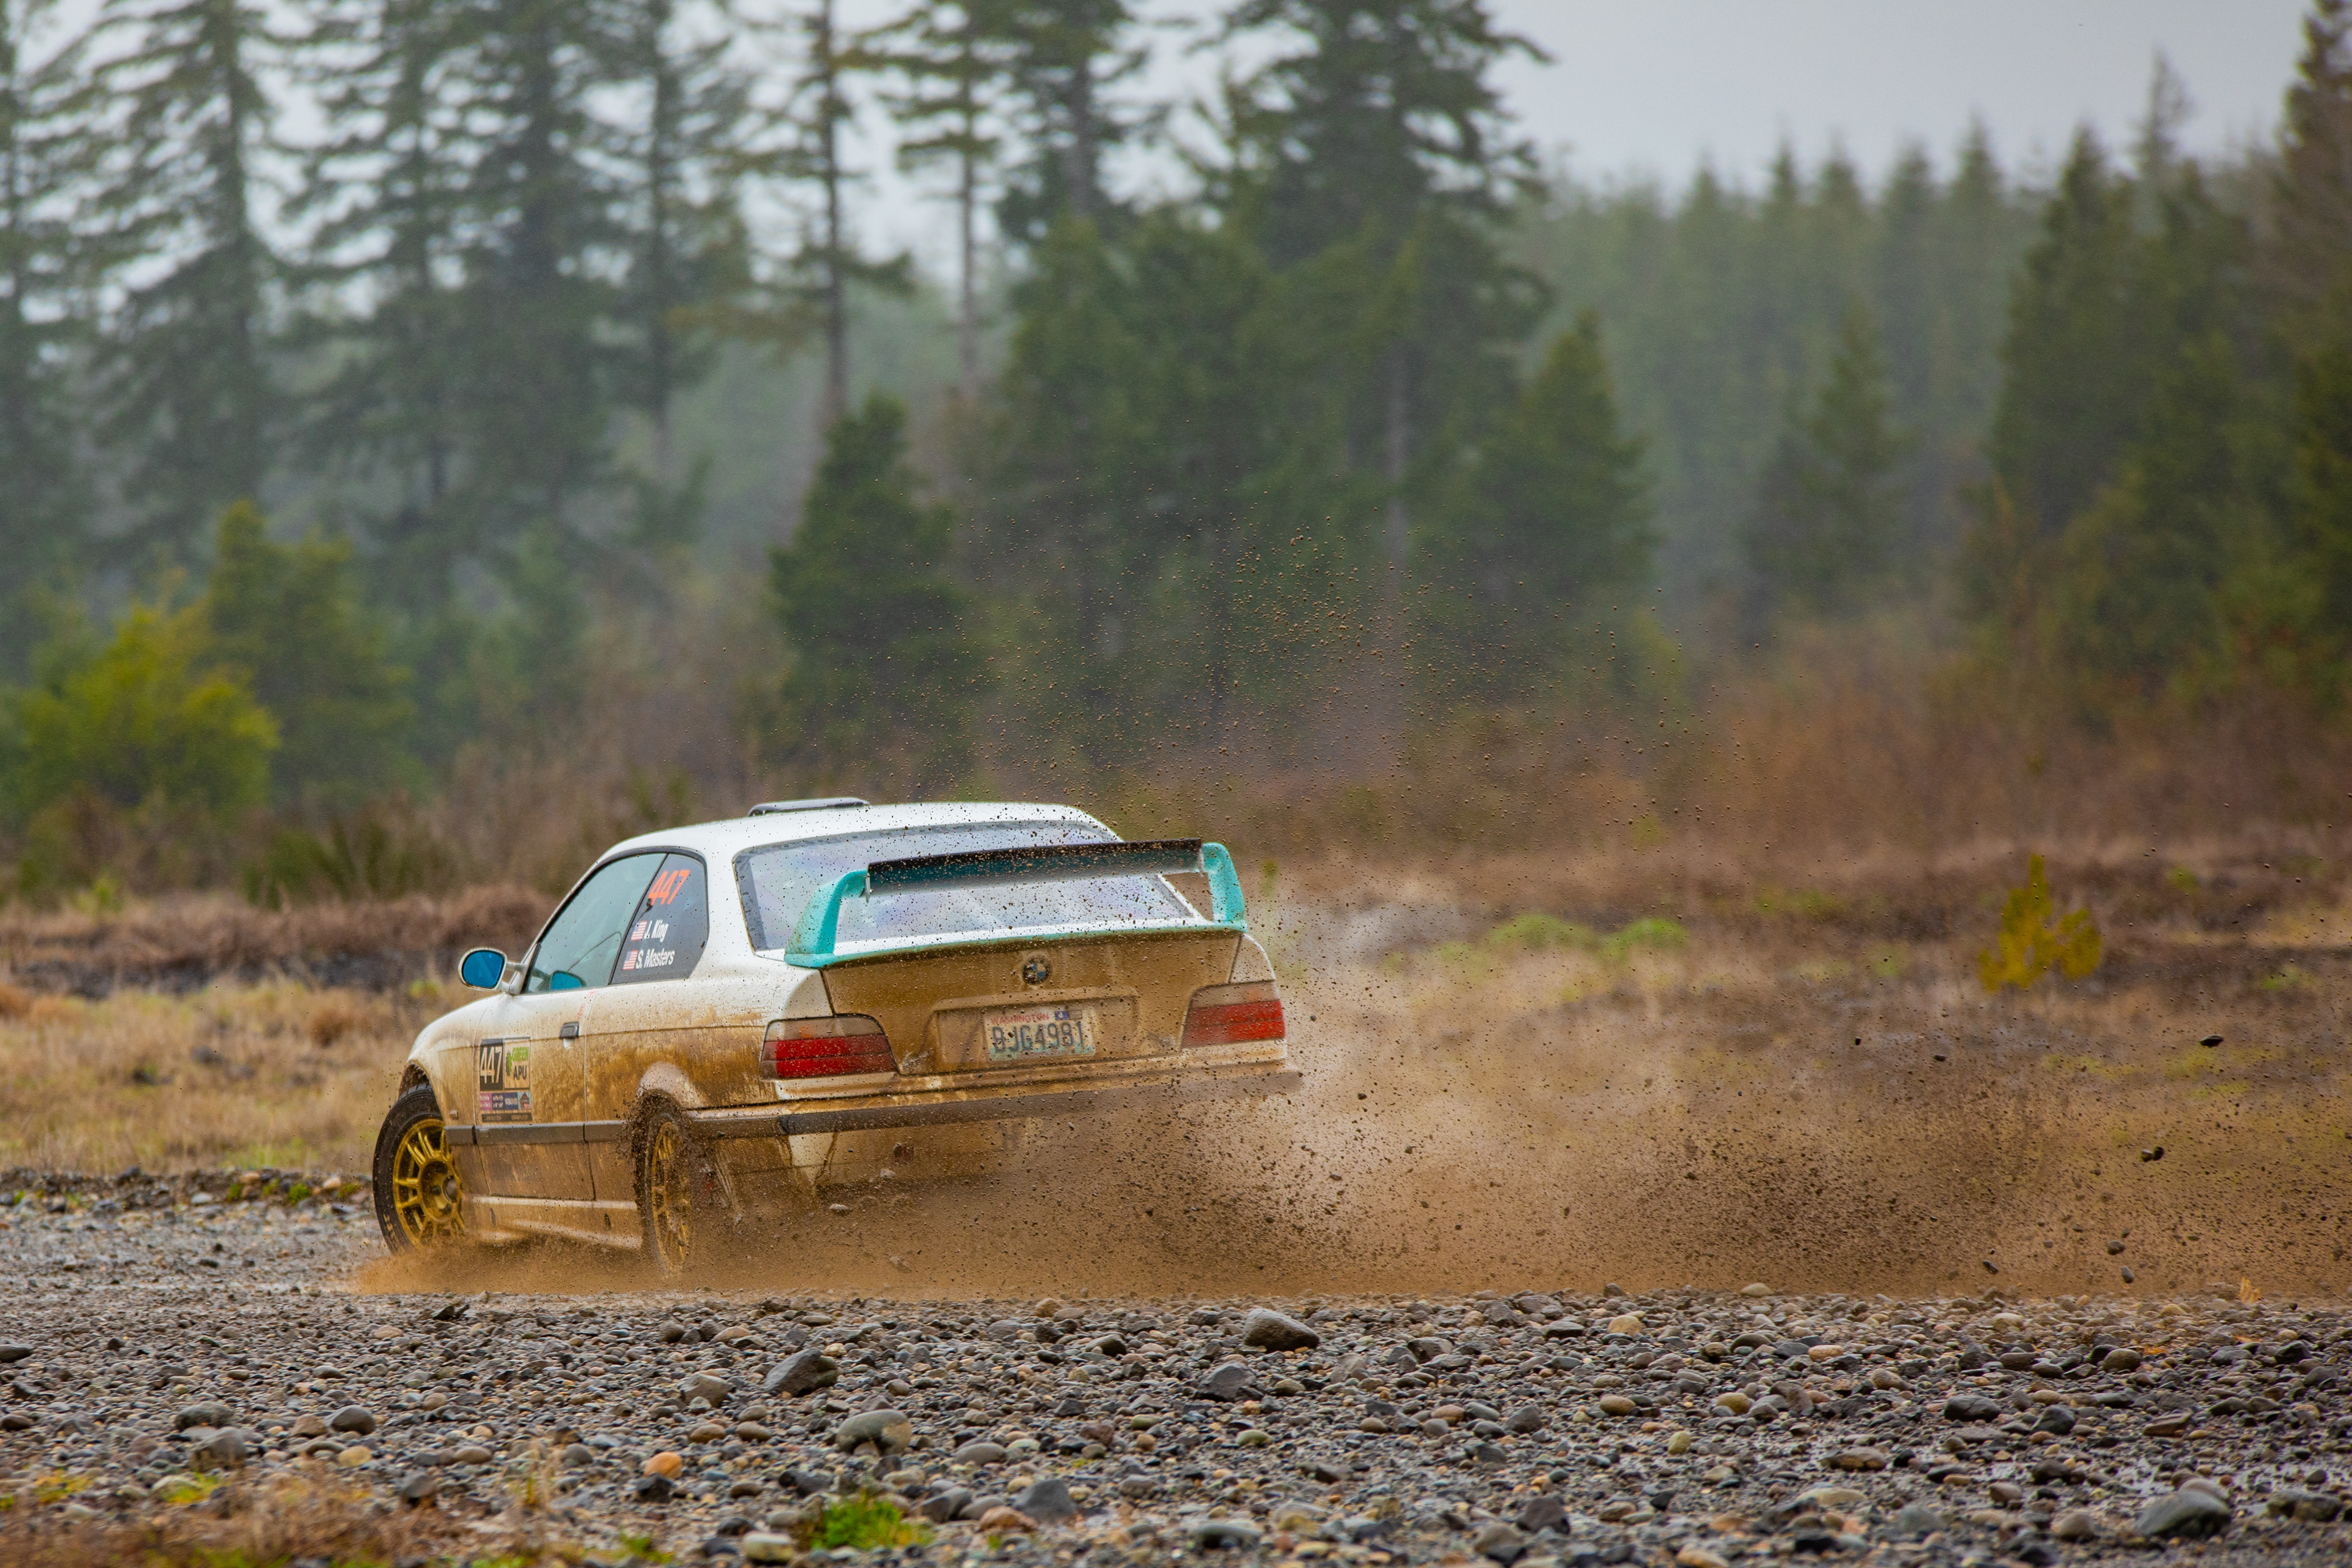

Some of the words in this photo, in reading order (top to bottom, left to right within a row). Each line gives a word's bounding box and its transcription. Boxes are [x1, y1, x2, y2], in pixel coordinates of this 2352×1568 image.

[647, 869, 690, 906] 447
[644, 920, 653, 940] J.
[651, 919, 669, 943] King
[635, 949, 644, 970] S.
[643, 948, 676, 968] Masters
[990, 1012, 1049, 1025] WASHINGTON
[480, 1046, 503, 1084] 447
[512, 1046, 530, 1062] GREEN
[513, 1065, 527, 1080] APU
